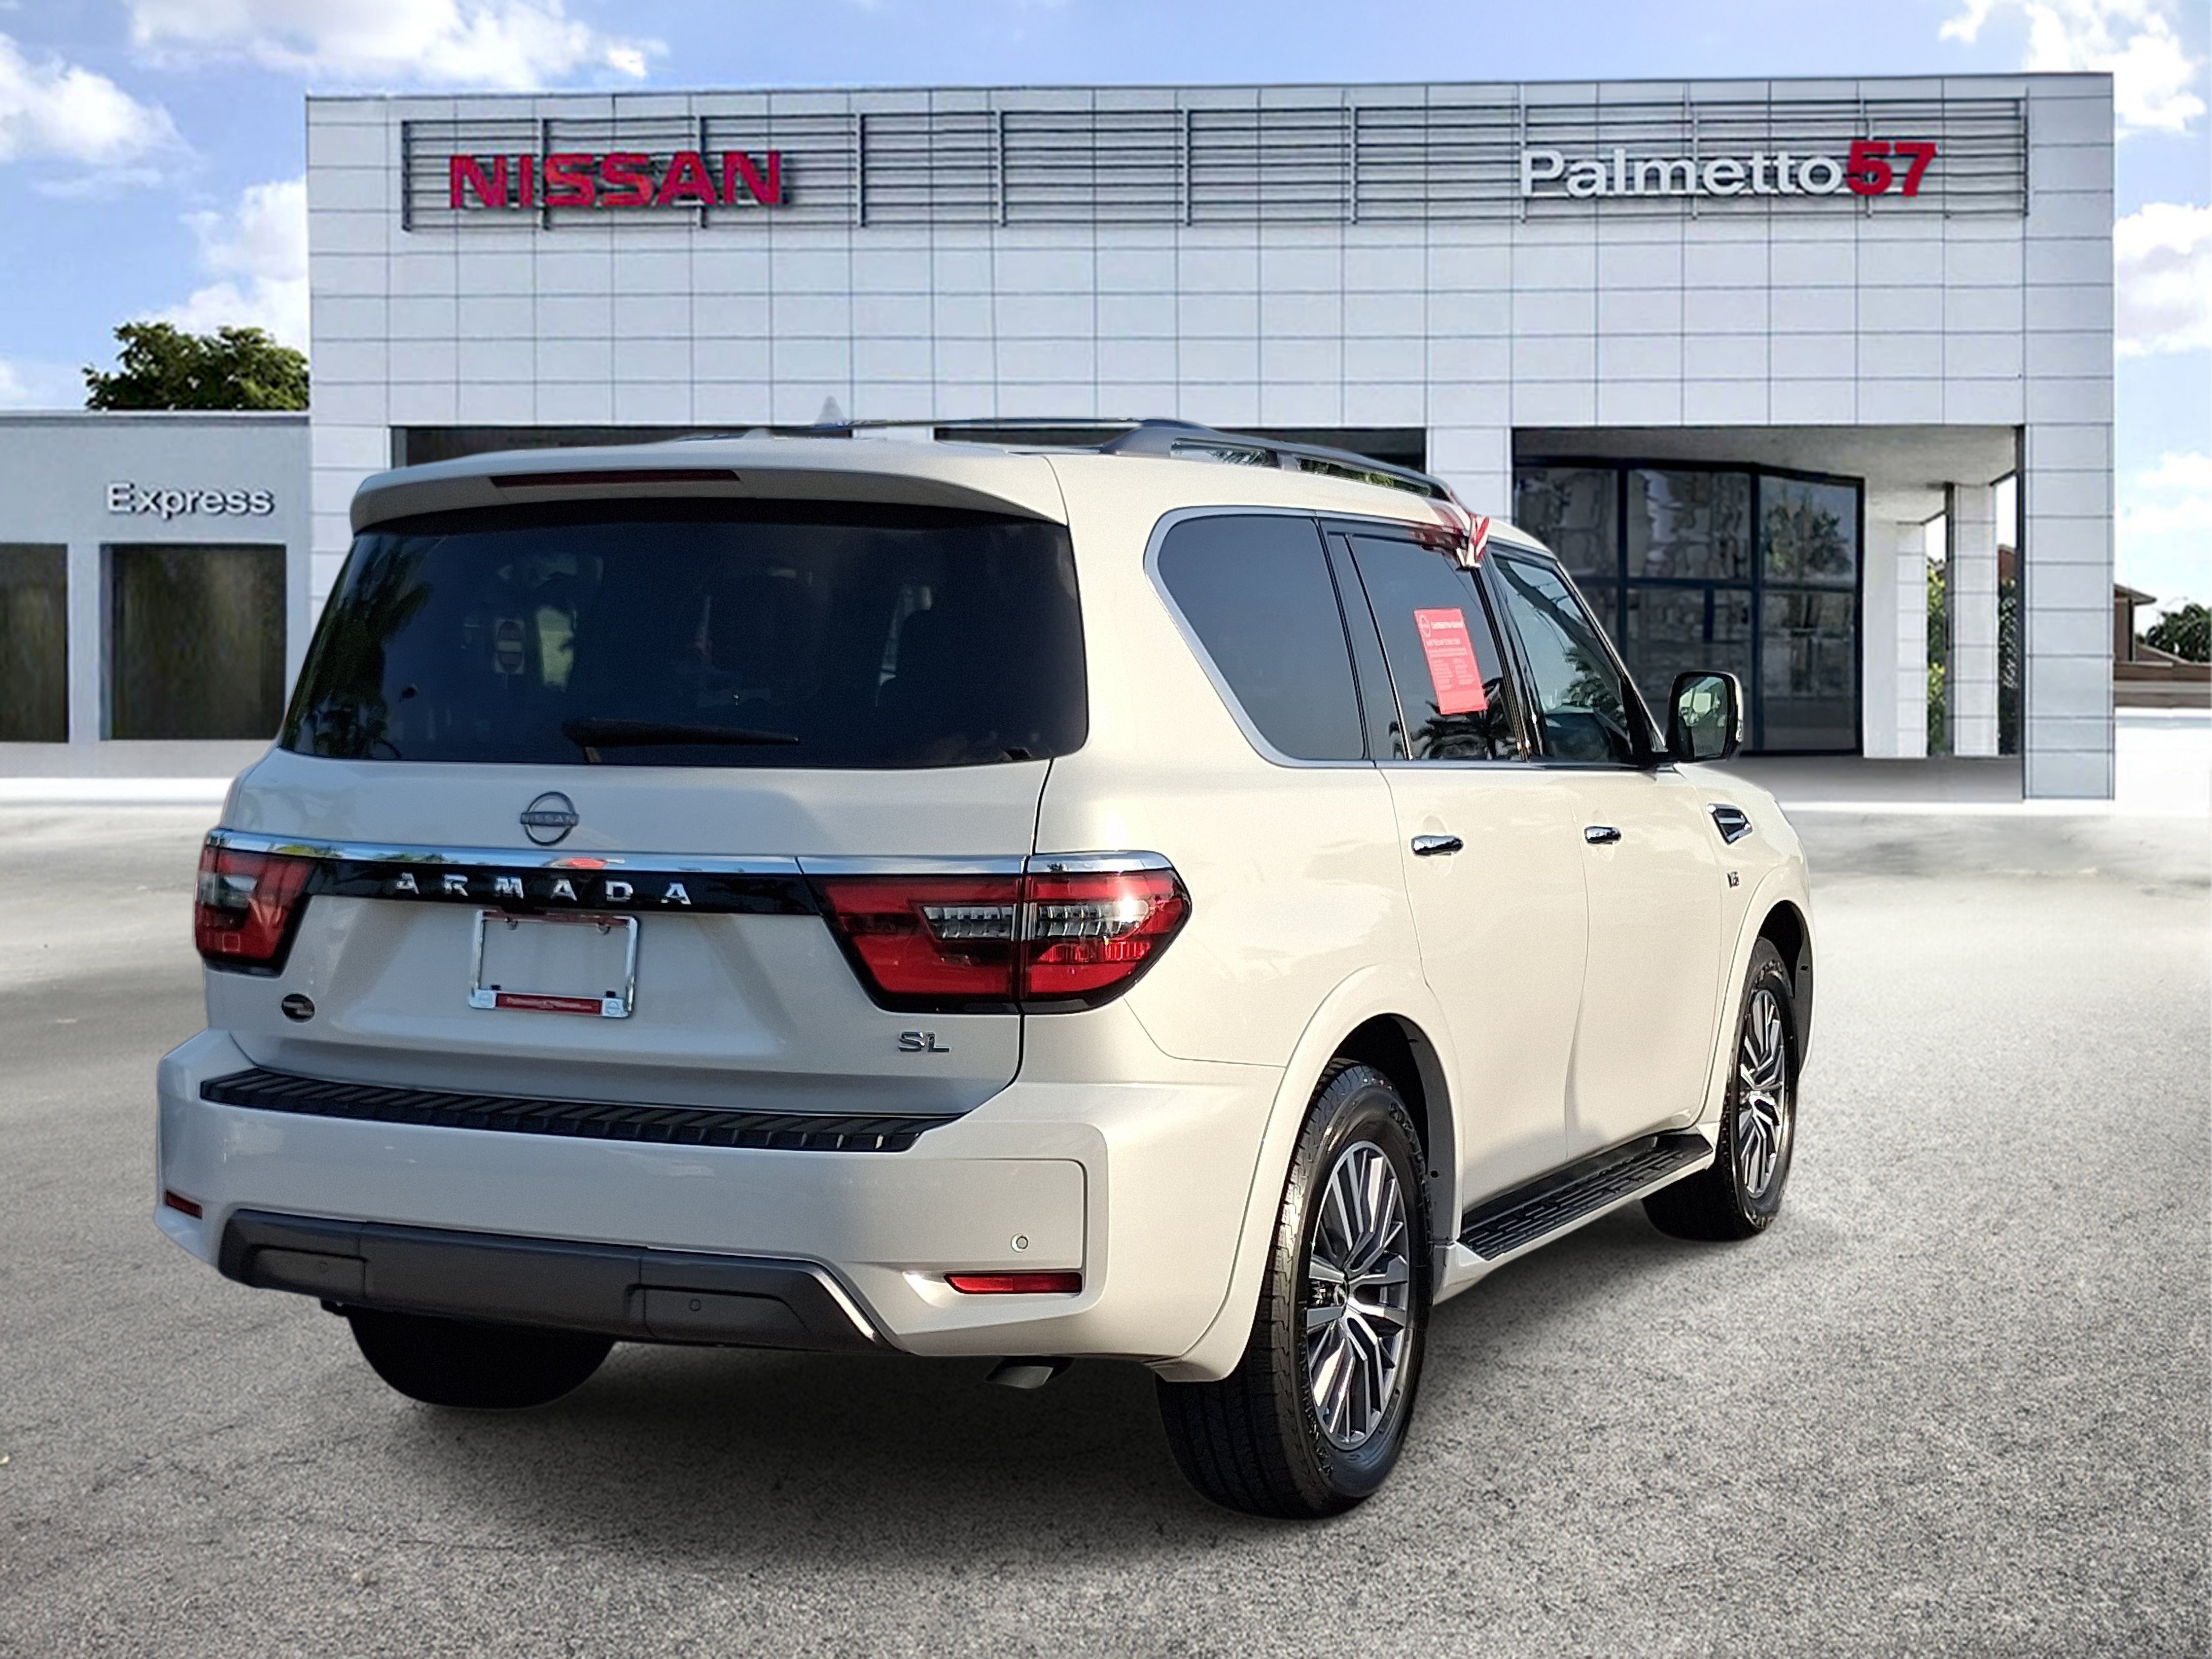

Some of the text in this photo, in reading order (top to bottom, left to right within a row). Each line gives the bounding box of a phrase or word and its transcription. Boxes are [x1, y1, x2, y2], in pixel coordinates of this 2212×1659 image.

[450, 151, 781, 209] NISSAN
[107, 482, 275, 520] Express
[522, 813, 577, 825] NISSAN
[395, 872, 691, 905] ARMADA
[898, 1031, 951, 1052] SL
